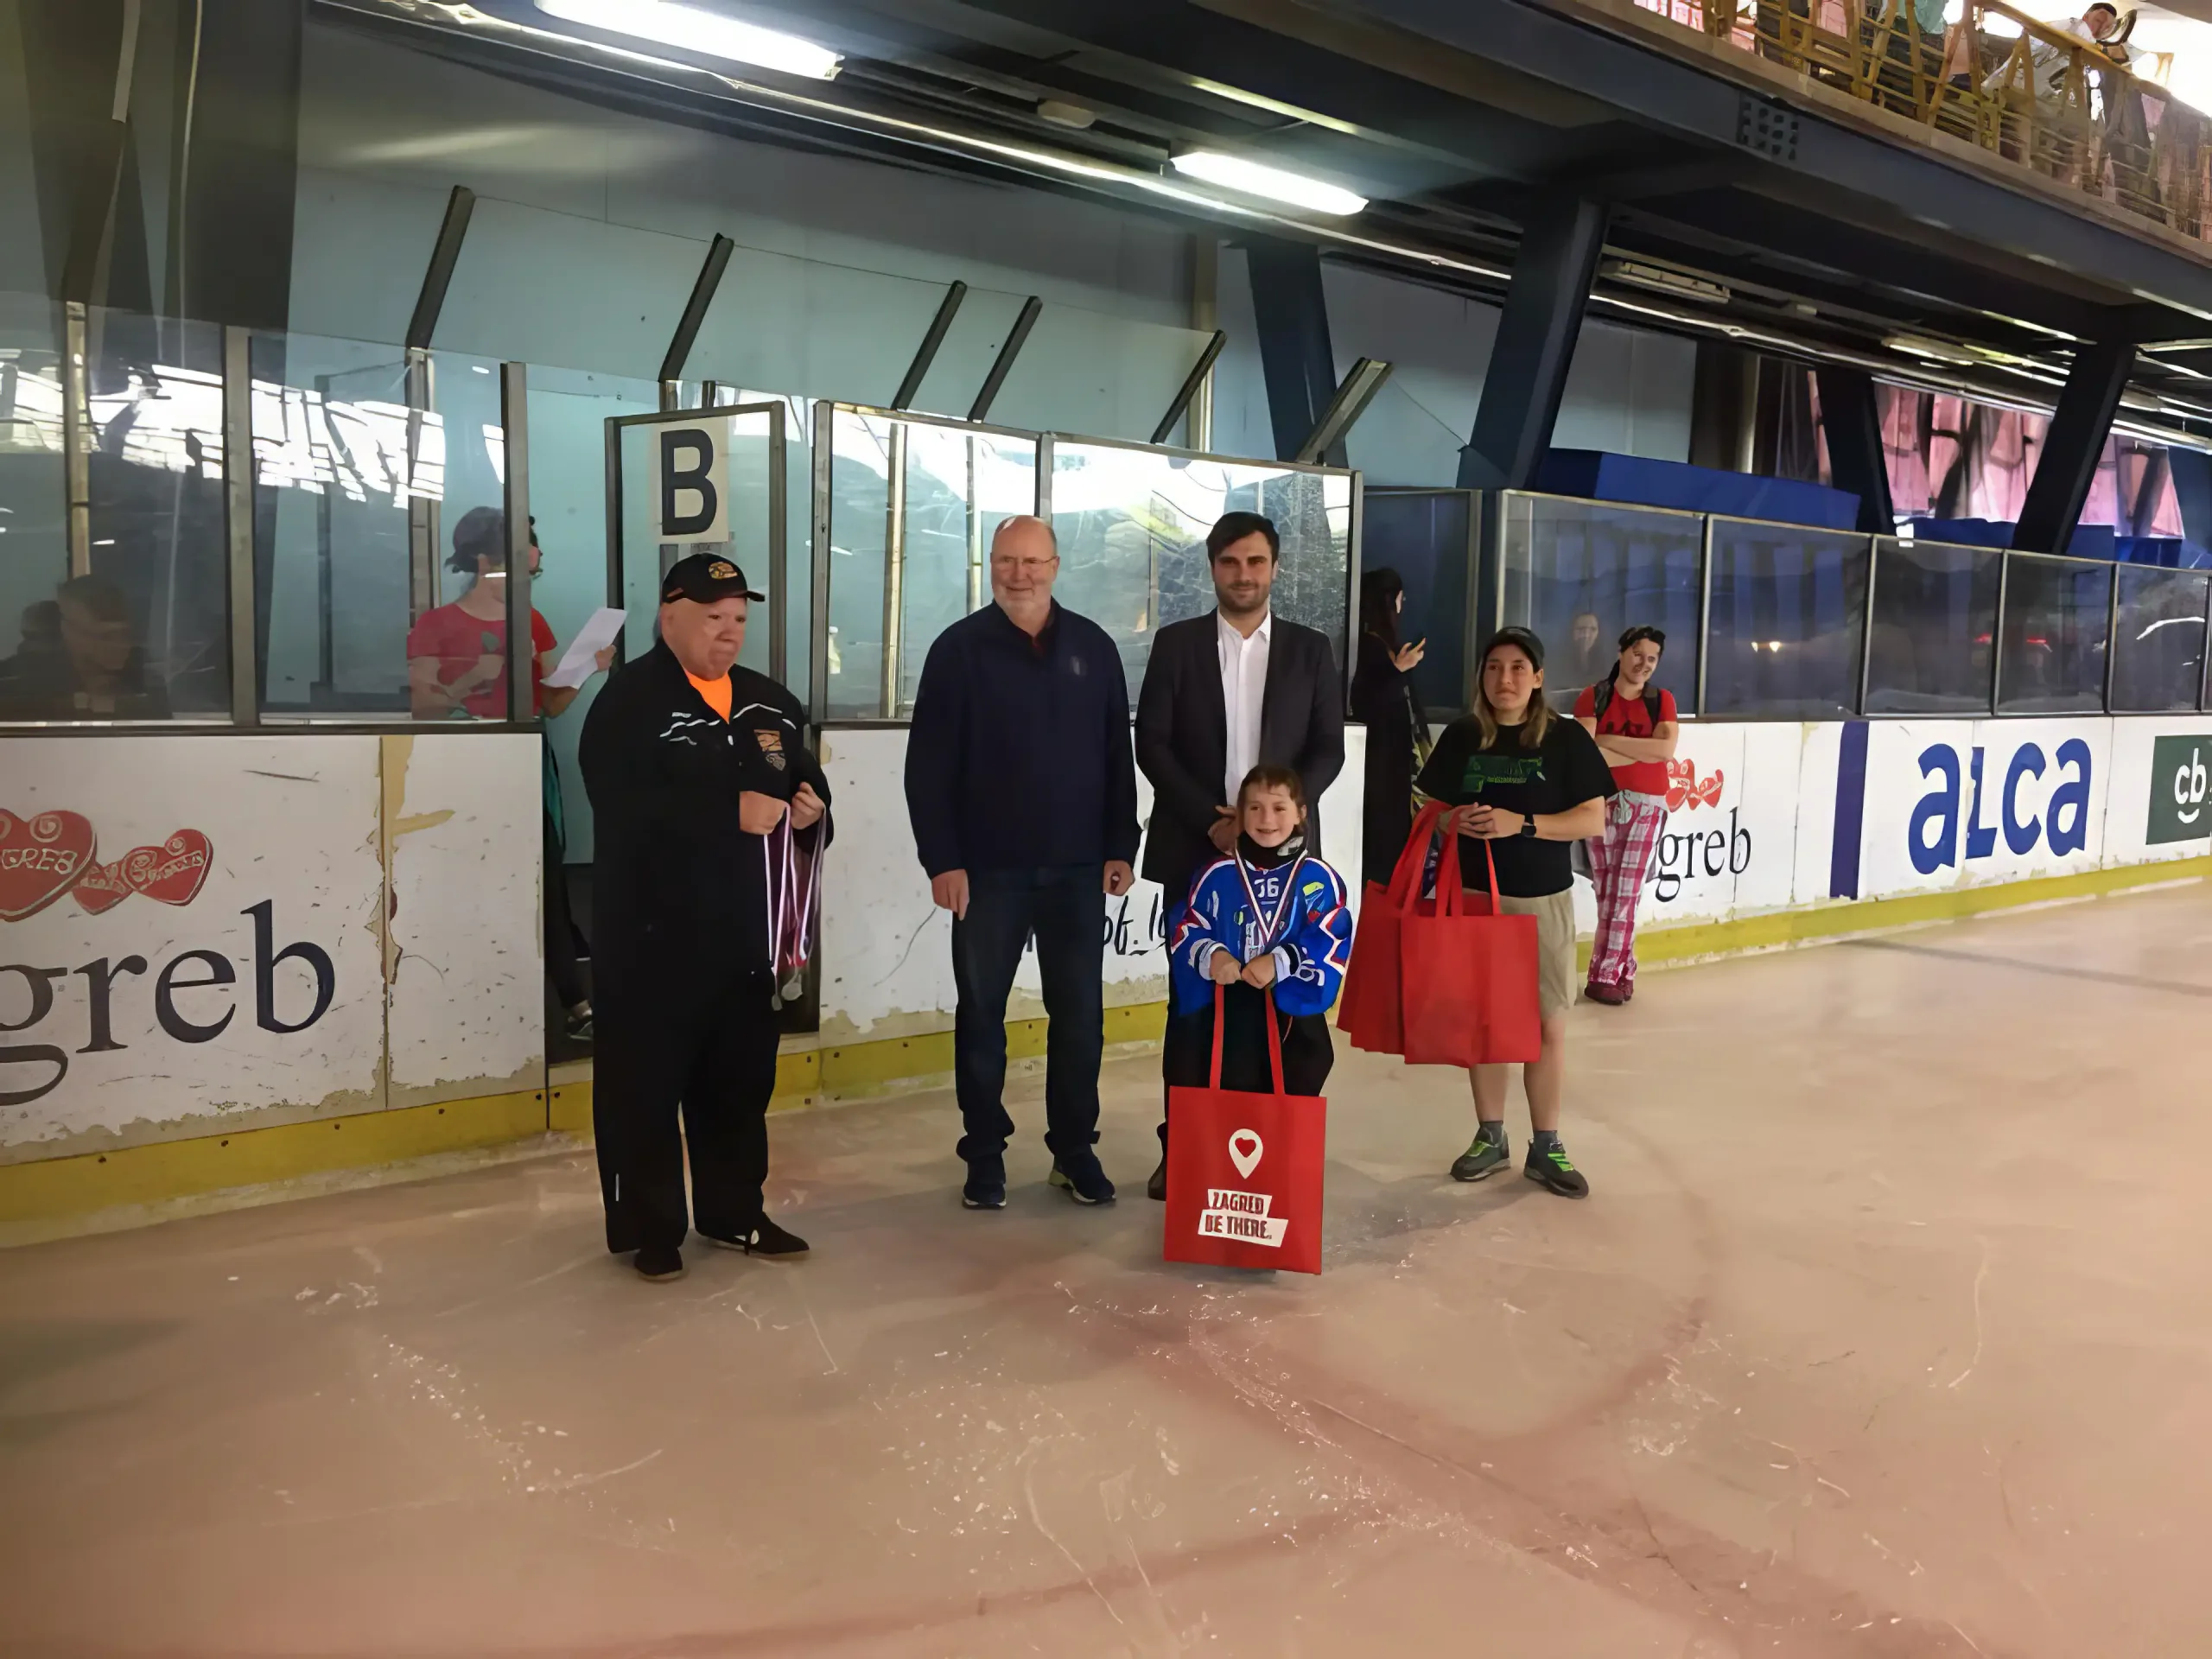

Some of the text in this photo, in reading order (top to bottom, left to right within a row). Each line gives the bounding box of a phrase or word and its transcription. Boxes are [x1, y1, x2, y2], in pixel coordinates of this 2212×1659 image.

[660, 428, 718, 536] B
[0, 899, 335, 1106] greb
[1205, 1213, 1223, 1233] BE
[1212, 1192, 1264, 1215] ZAGREB
